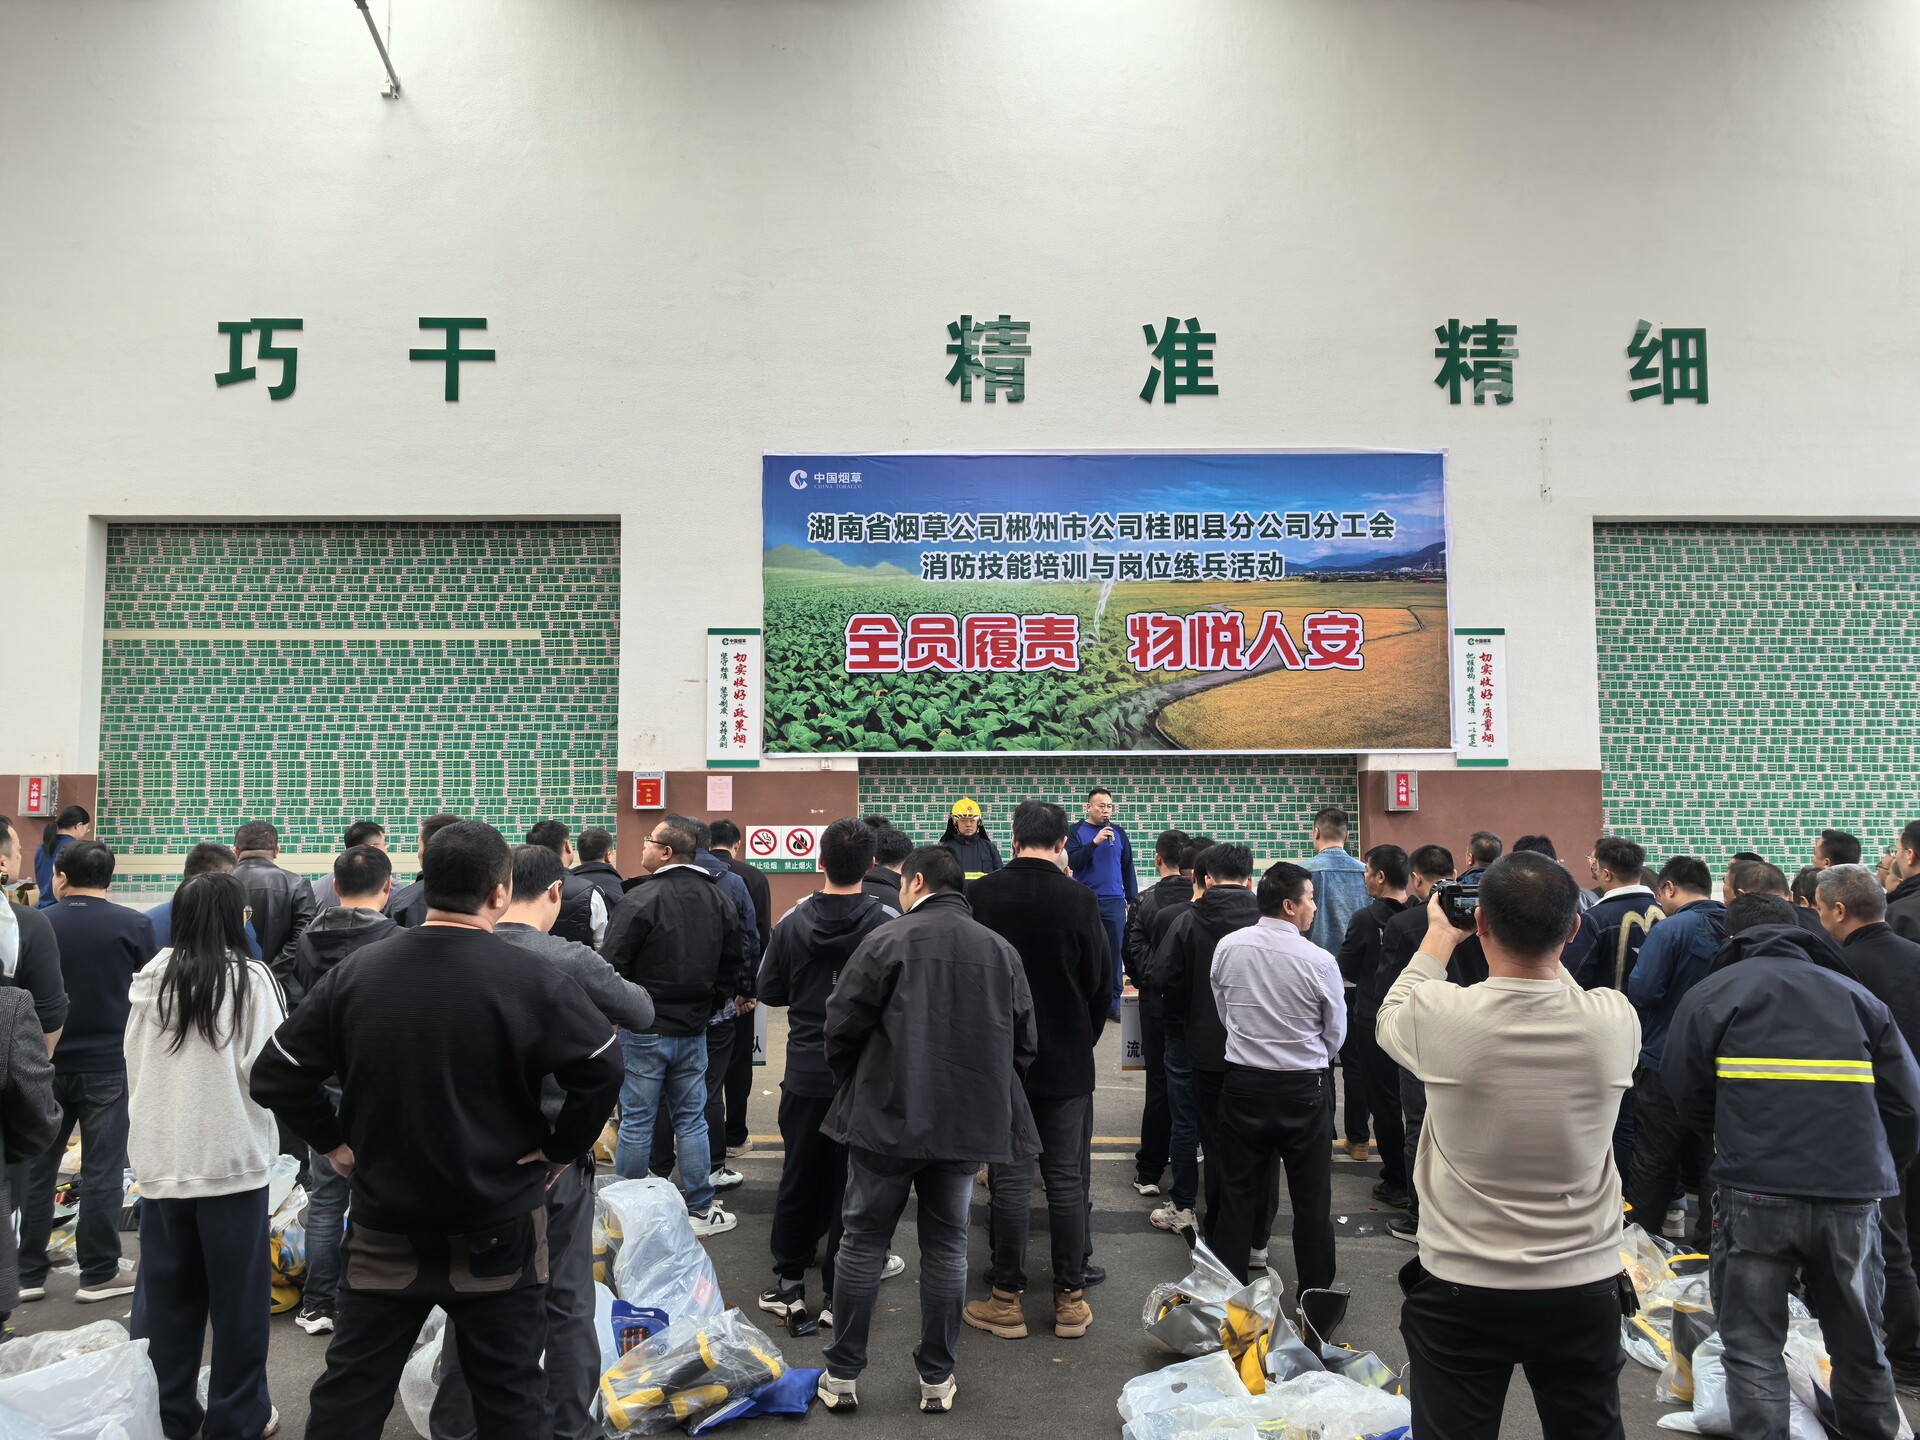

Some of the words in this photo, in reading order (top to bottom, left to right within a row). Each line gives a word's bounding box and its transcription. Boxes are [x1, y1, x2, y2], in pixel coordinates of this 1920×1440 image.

[214, 317, 496, 402] 巧干
[945, 315, 1219, 404] 精准
[1434, 318, 1709, 405] 精细
[814, 472, 862, 483] 中国烟草
[808, 512, 1396, 542] 湖南省烟草公司郴州市公司桂阳县分公司分工会
[921, 551, 1284, 580] 消防技能培训与岗位练兵活动
[846, 615, 1078, 671] 全员履责
[1128, 613, 1362, 669] 物悦人安
[784, 861, 813, 870] 禁止烟火
